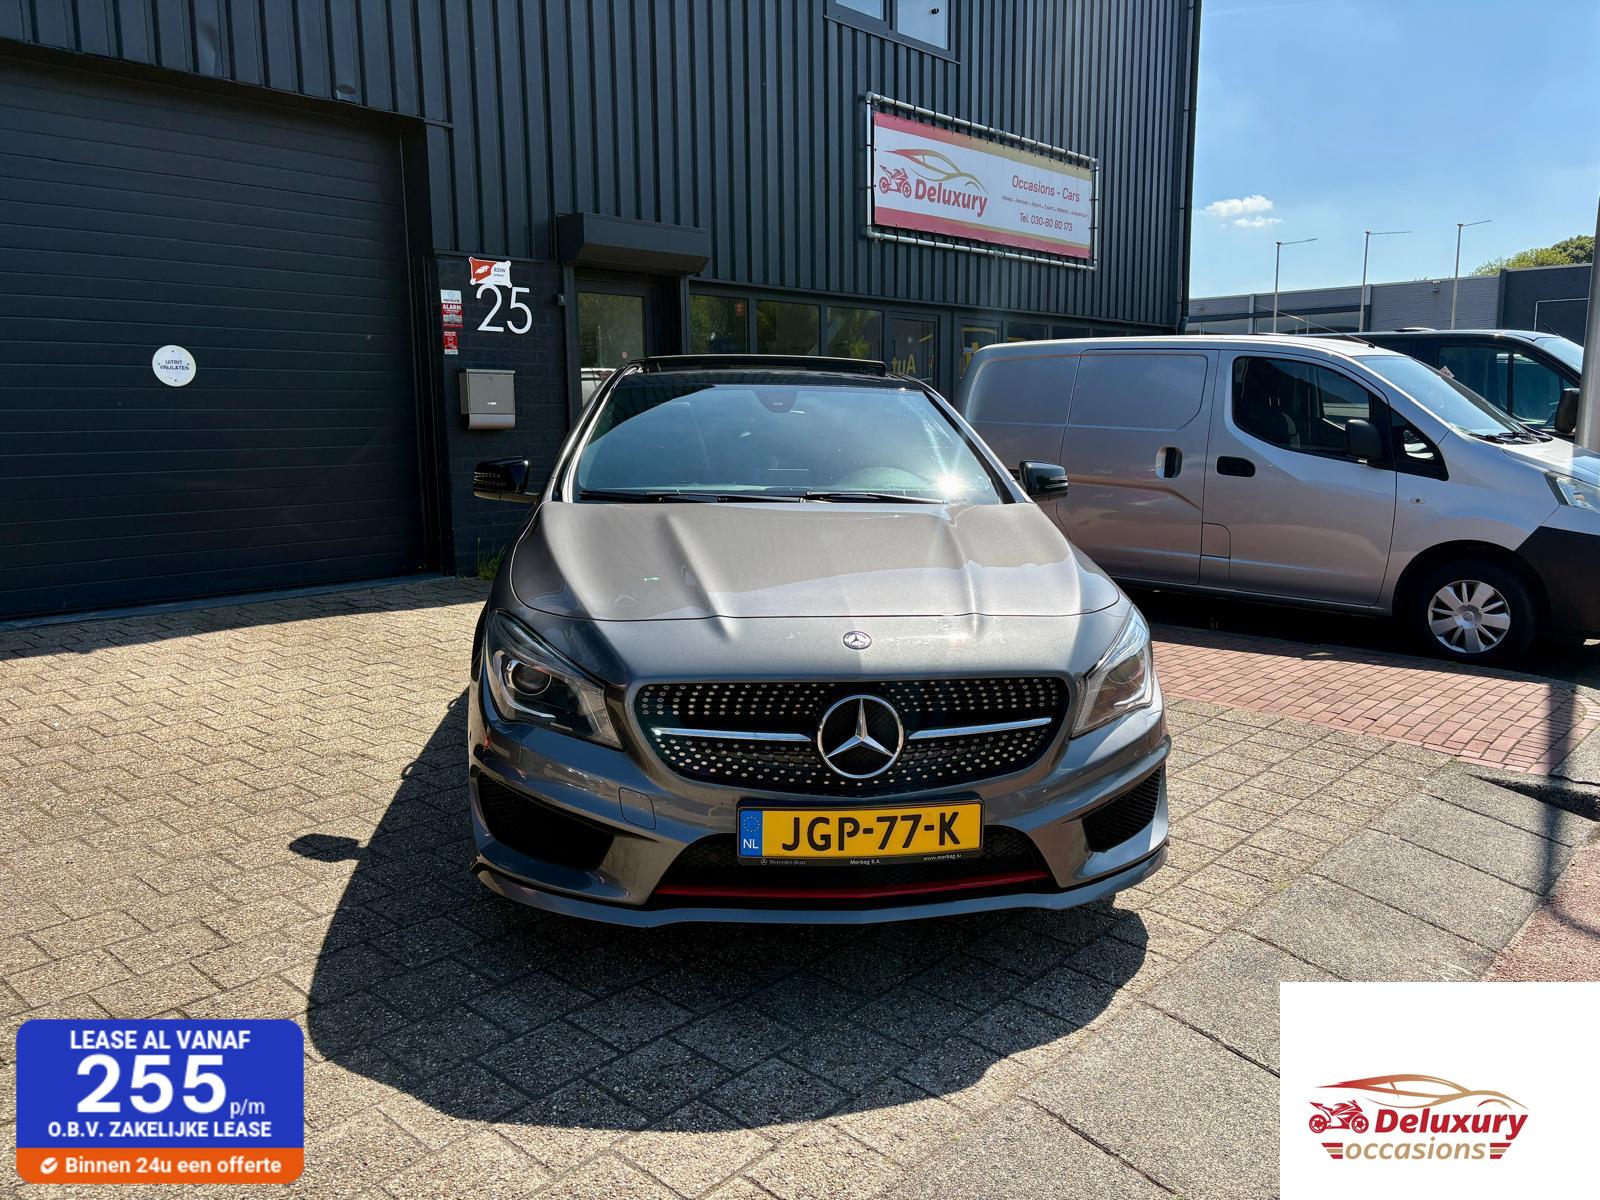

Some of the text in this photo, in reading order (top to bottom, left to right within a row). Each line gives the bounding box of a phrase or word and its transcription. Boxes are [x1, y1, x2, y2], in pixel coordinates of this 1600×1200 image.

[915, 178, 988, 217] Deluxury
[1012, 175, 1055, 197] Occasions
[1062, 187, 1080, 202] Cars
[1030, 215, 1053, 228] 030-80
[1054, 219, 1062, 229] 80
[1063, 222, 1073, 231] 173
[476, 283, 532, 335] 25
[743, 838, 759, 849] NL
[782, 811, 960, 852] JGP-77-K
